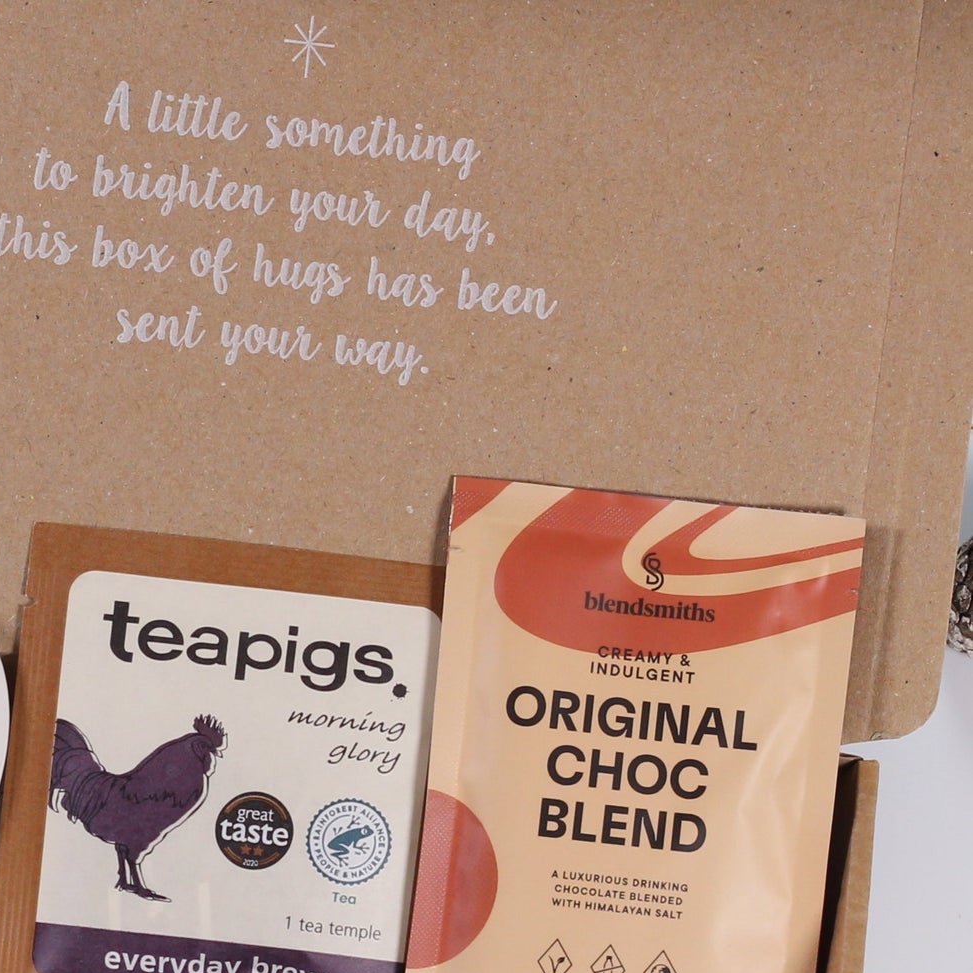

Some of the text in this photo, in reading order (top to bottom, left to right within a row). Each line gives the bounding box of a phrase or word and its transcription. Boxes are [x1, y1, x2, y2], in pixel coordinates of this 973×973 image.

[104, 81, 481, 179] A little something
[32, 147, 497, 252] to brighten your day,
[93, 226, 174, 272] box
[190, 238, 238, 294] of
[253, 244, 351, 303] hugs
[368, 257, 443, 308] has
[458, 268, 557, 320] been
[116, 305, 428, 385] sent your way.
[583, 590, 715, 622] blendsmiths
[597, 645, 691, 666] CREAMY &
[590, 662, 696, 684] INDULGENT
[287, 709, 407, 741] morning
[506, 685, 758, 751] ORIGINAL
[328, 741, 401, 774] glory
[547, 744, 709, 801] CHOC
[236, 808, 275, 822] great
[313, 805, 386, 848] RAINFOREST ALLIANCE
[537, 798, 708, 853] BLEND
[220, 818, 289, 846] taste
[315, 849, 339, 877] PEOPLE
[351, 855, 381, 878] NATURE
[551, 870, 689, 893] A LUXURIOUS DRINKING
[554, 884, 683, 905] CHOCOLATE BLENDED
[332, 891, 357, 905] Tea
[552, 898, 683, 920] WITH HIMALAYAN SALT
[285, 916, 382, 944] 1 tea temple
